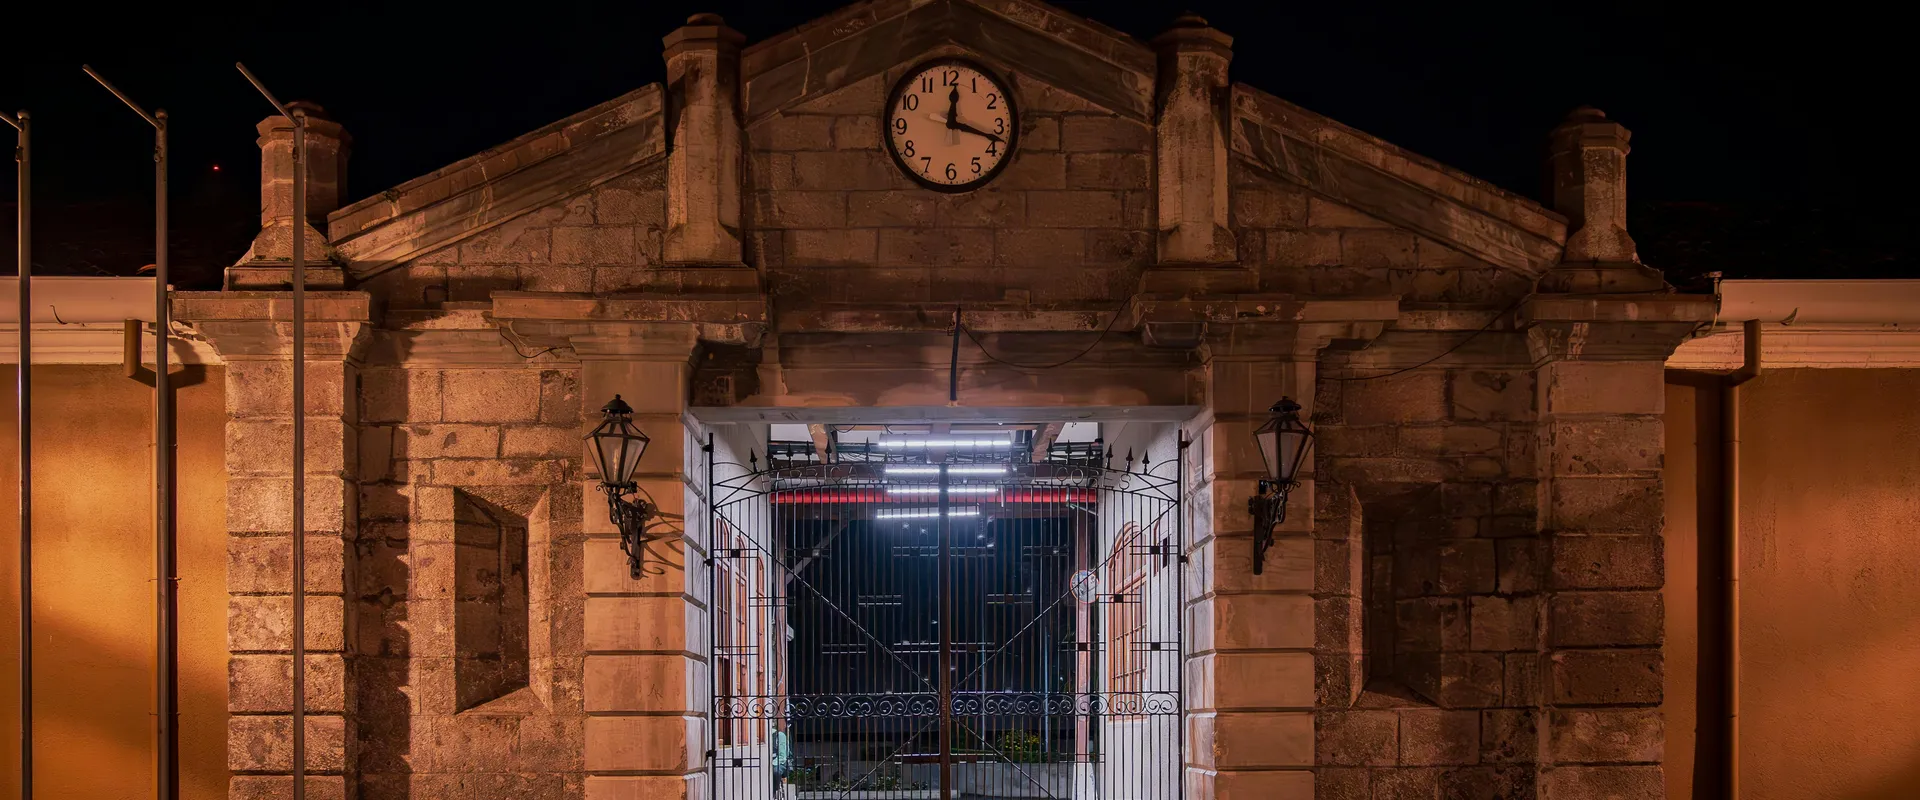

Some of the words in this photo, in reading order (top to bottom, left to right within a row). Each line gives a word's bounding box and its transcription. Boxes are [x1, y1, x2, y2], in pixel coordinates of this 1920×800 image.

[922, 77, 933, 93] 11
[943, 70, 959, 86] 12
[972, 77, 977, 93] 1
[903, 94, 918, 110] 10
[987, 93, 996, 109] 2
[896, 118, 907, 134] 9
[994, 118, 1004, 134] 3
[904, 140, 915, 157] 8
[985, 140, 997, 156] 4
[921, 157, 931, 173] 7
[946, 163, 956, 180] 6
[971, 157, 981, 173] 5
